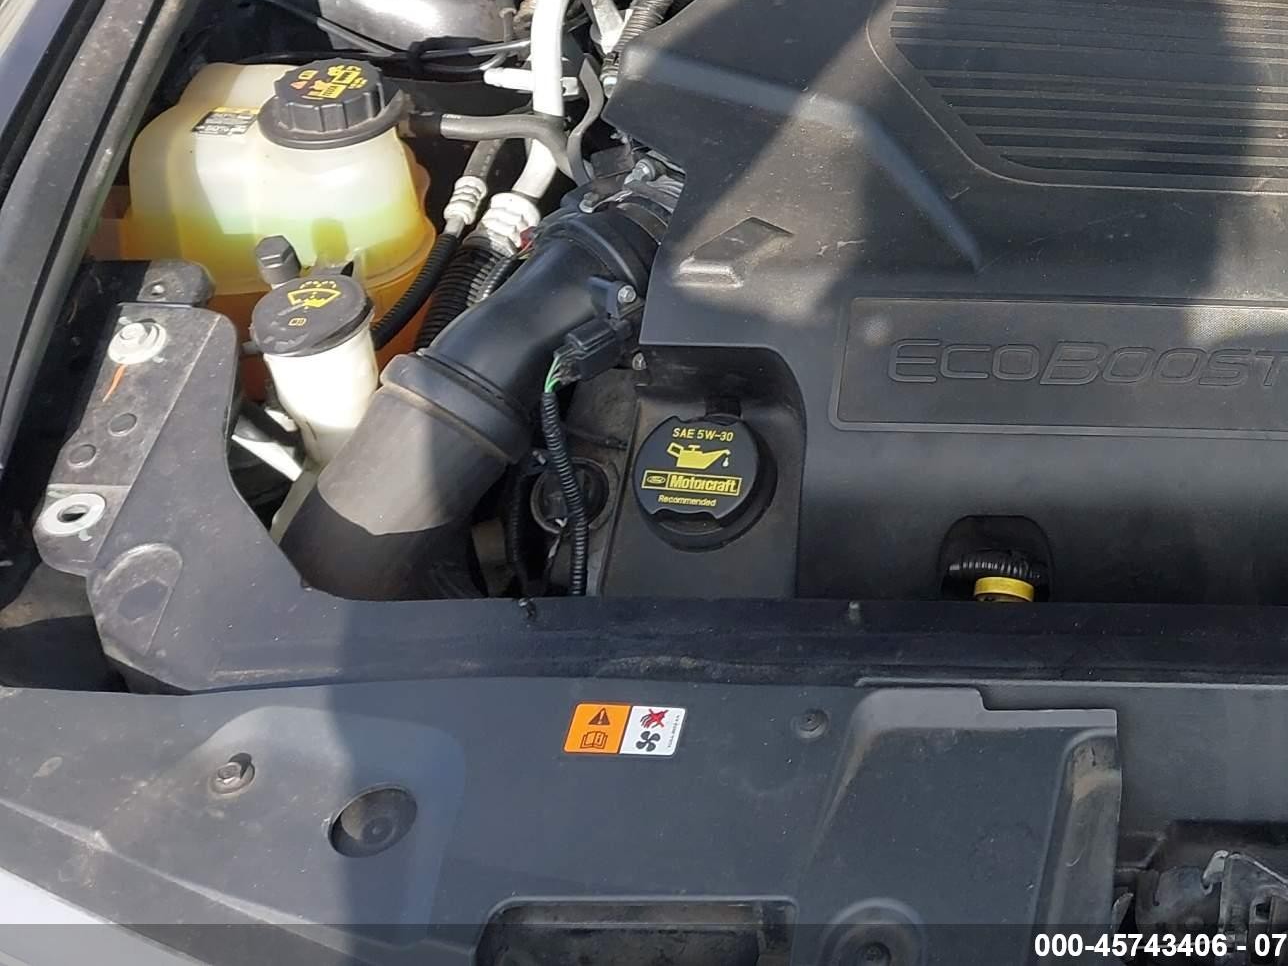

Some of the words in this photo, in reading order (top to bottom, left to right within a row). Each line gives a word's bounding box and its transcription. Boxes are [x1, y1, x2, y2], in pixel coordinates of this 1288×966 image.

[672, 427, 694, 439] SAE
[696, 429, 733, 442] 5W-30
[669, 475, 738, 493] Motorcraft
[658, 494, 717, 507] Recommended
